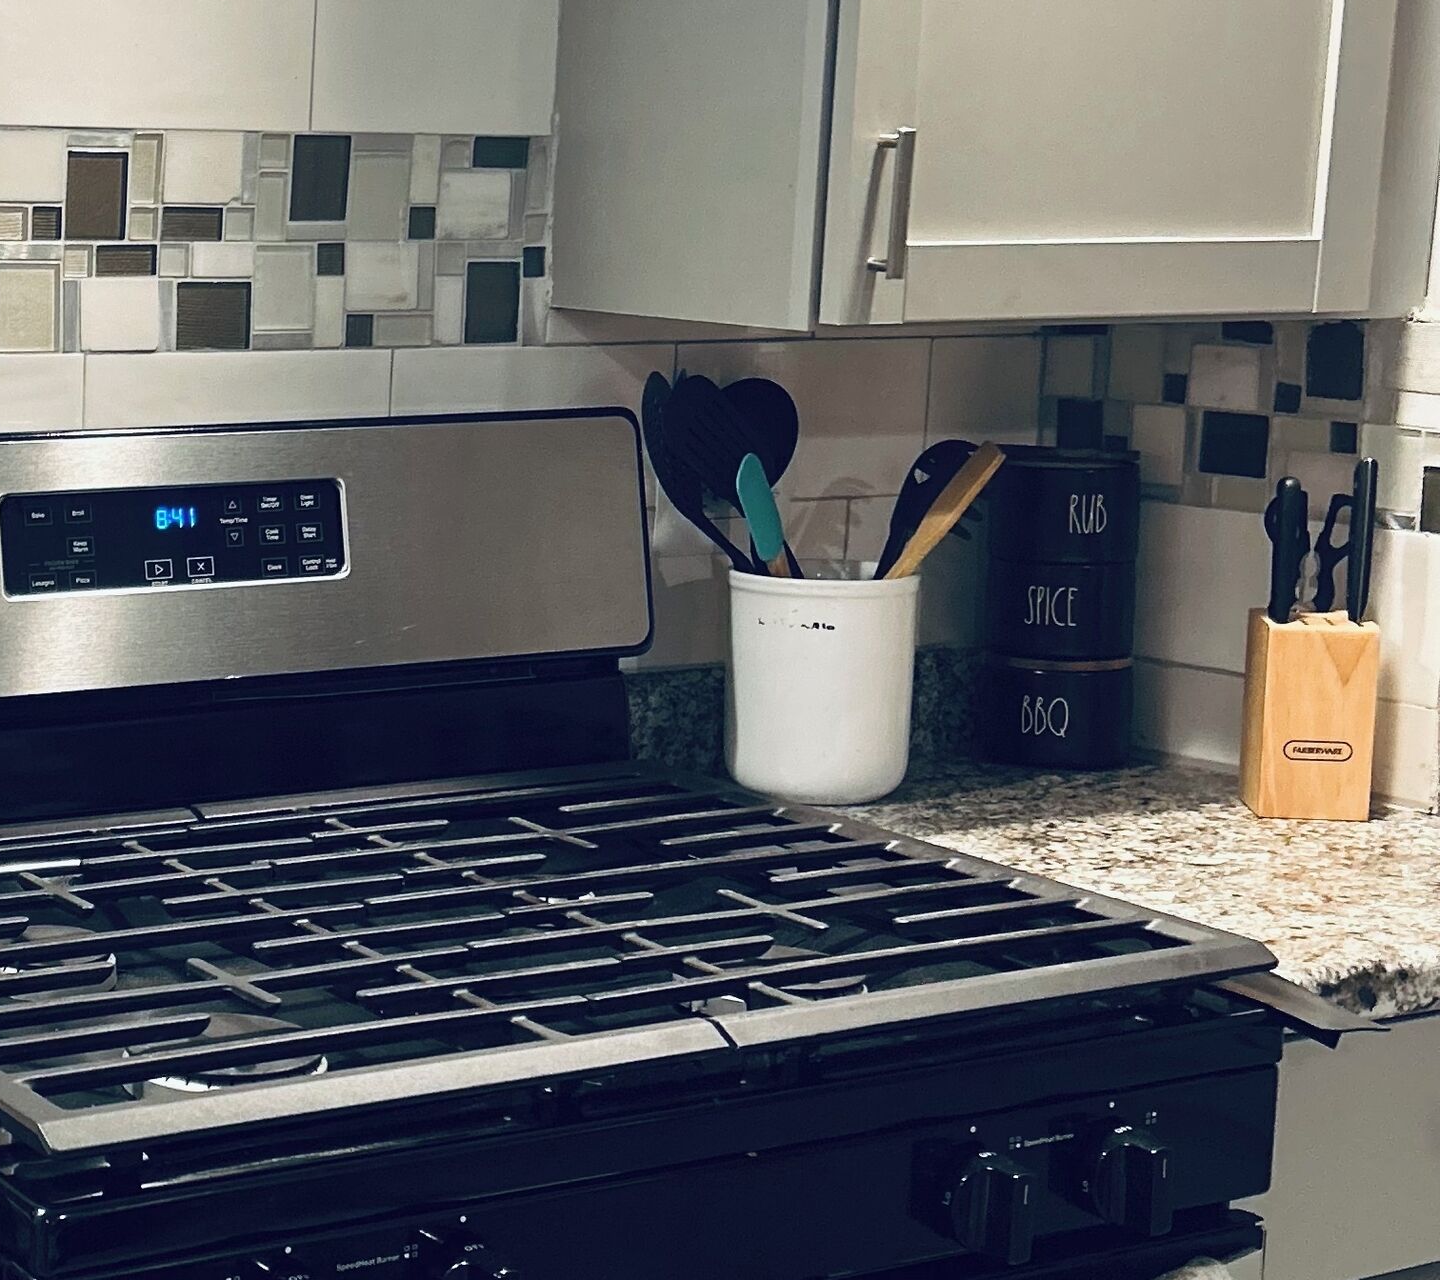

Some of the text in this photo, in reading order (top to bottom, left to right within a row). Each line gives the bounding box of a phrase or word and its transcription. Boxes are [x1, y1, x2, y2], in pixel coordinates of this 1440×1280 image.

[155, 507, 195, 529] 8:41
[1069, 494, 1107, 534] RUB
[1024, 586, 1078, 626] SPICE
[1021, 695, 1069, 737] BBQ
